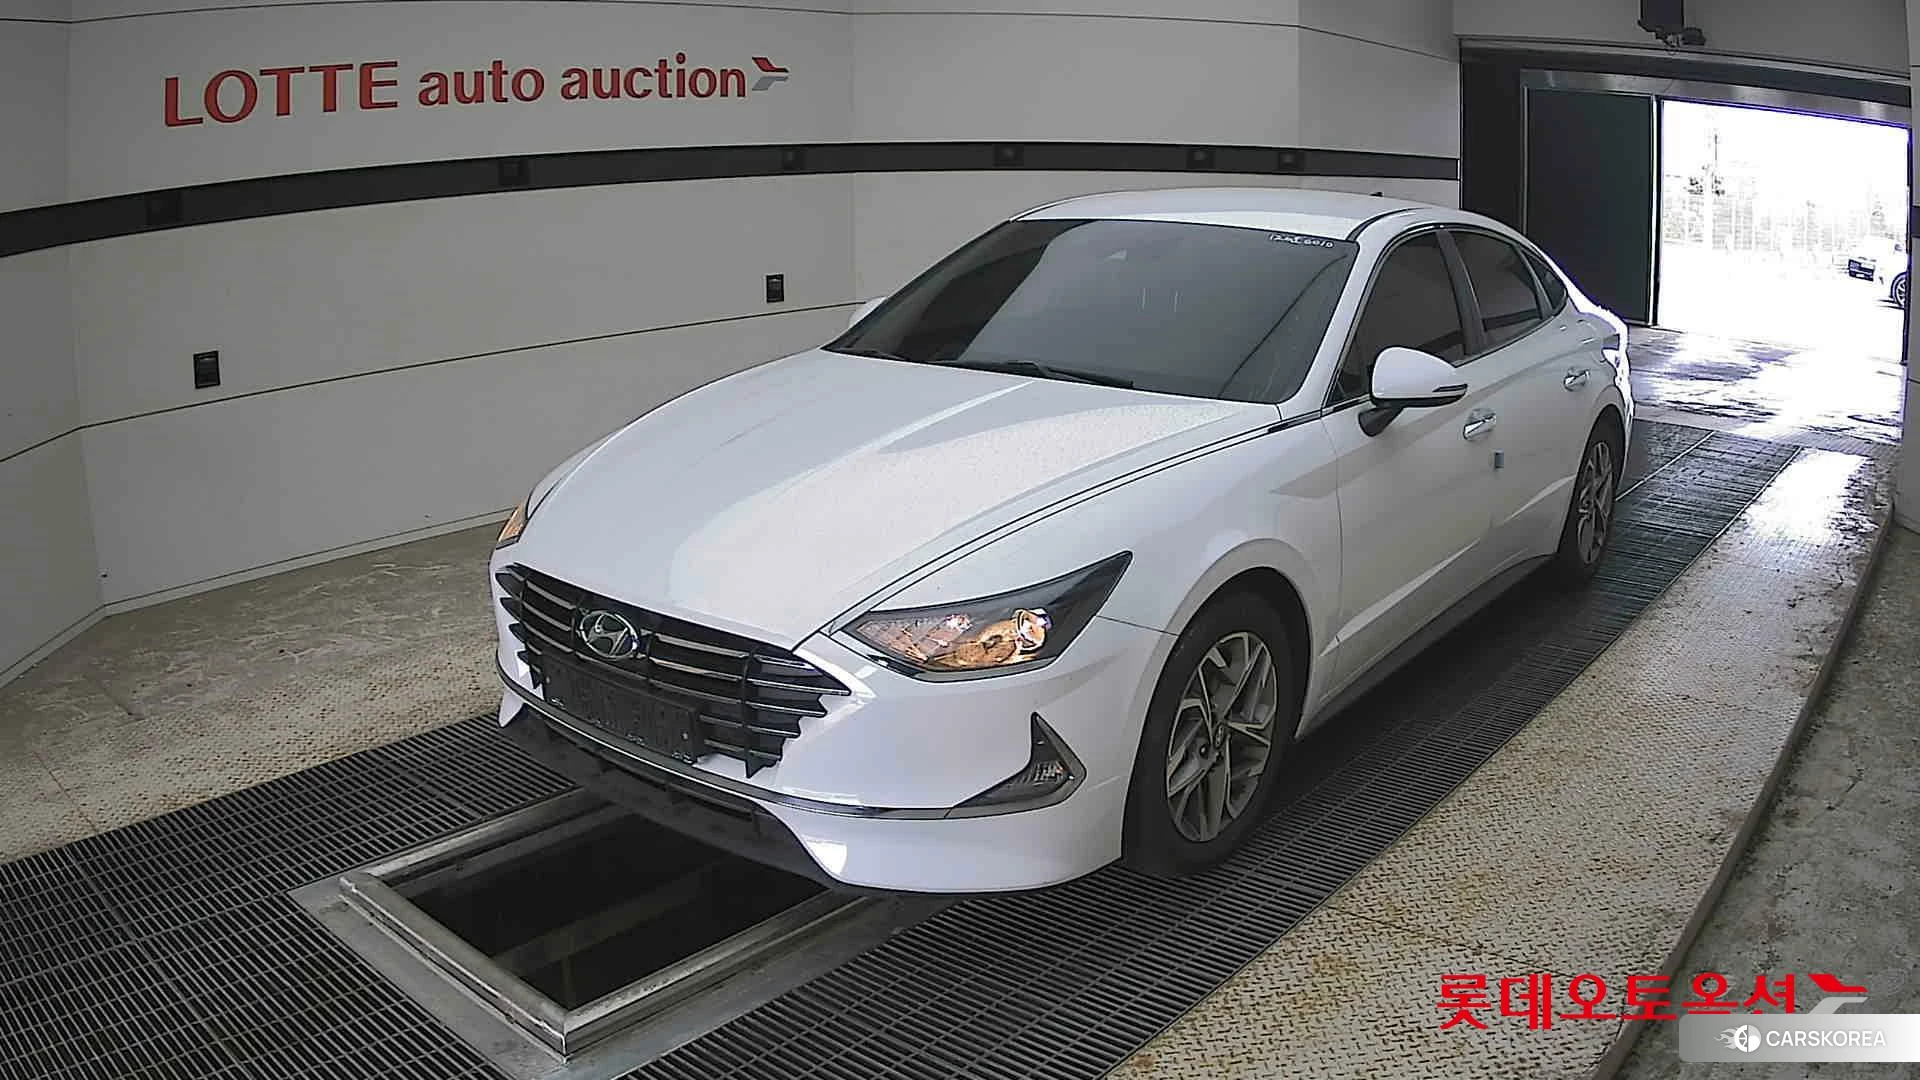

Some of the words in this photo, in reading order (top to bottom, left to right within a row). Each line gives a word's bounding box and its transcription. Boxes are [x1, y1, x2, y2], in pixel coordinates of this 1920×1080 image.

[164, 61, 399, 127] LOTTE
[418, 61, 544, 105] auto
[561, 52, 747, 98] auction
